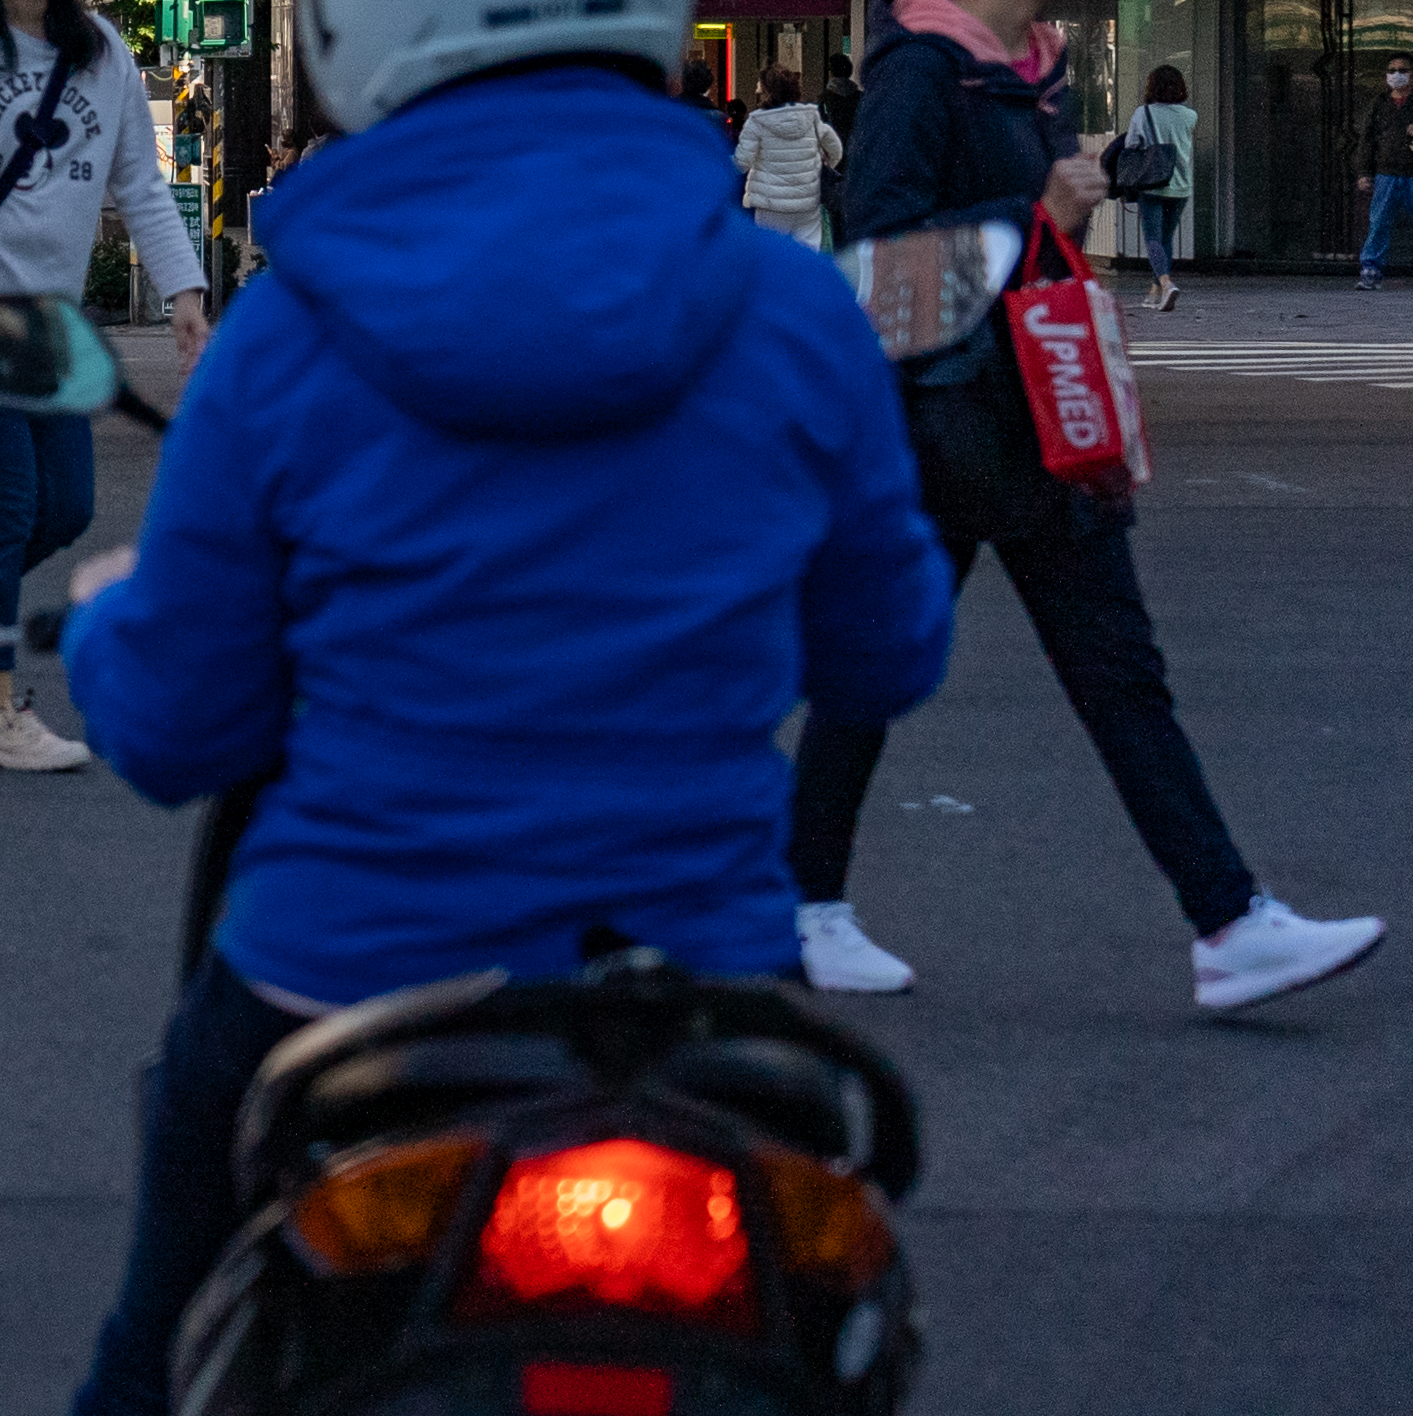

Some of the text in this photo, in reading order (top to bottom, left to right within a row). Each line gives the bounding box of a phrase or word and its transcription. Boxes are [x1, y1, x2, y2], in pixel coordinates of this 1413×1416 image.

[62, 86, 102, 140] OUSE
[69, 159, 92, 181] 28
[1024, 303, 1100, 450] JPMED
